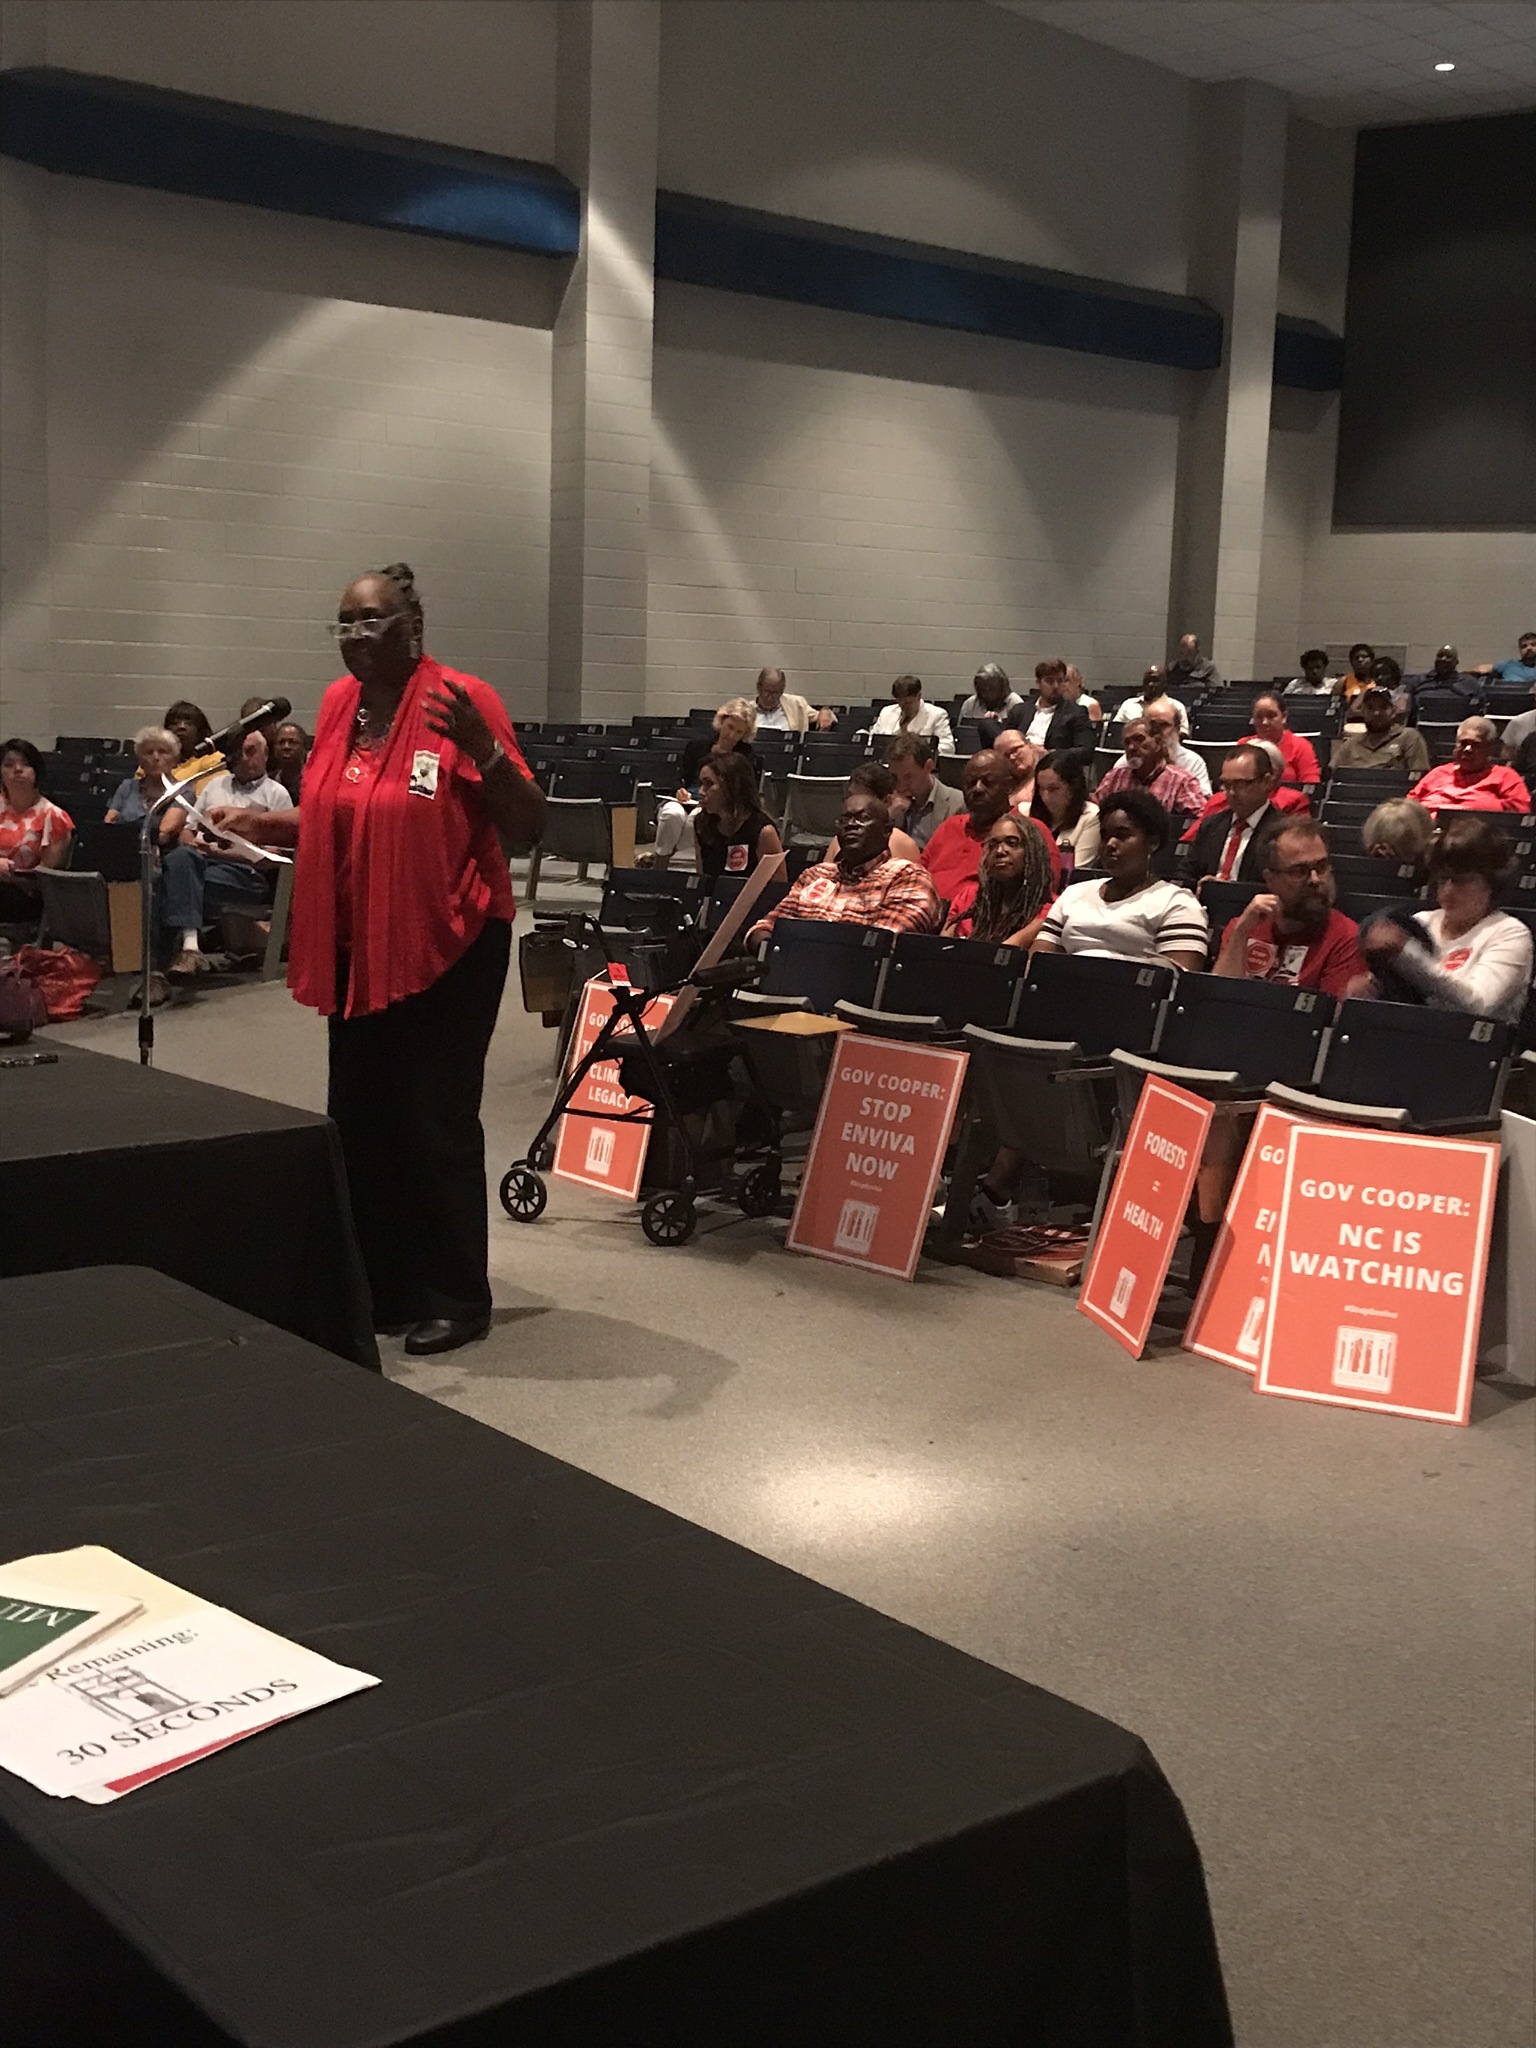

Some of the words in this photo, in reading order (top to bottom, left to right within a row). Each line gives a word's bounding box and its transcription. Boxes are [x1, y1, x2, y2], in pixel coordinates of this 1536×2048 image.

[589, 1064, 620, 1085] CLIM
[841, 1067, 875, 1086] GOV
[877, 1073, 947, 1101] COOPER:
[588, 1085, 633, 1110] LEGACY
[860, 1097, 912, 1123] STOP
[840, 1122, 915, 1156] ENVIVA
[1143, 1131, 1188, 1171] FORESTS
[1259, 1144, 1285, 1165] GO
[845, 1152, 900, 1181] NOW
[1300, 1179, 1354, 1202] GOV
[1361, 1186, 1471, 1217] COOPER:
[1122, 1200, 1164, 1241] HEALTH
[1338, 1223, 1384, 1250] NC
[1393, 1230, 1422, 1255] IS
[1290, 1250, 1464, 1296] WATCHING
[57, 1741, 107, 1766] 30
[110, 1678, 299, 1749] SECONDS
